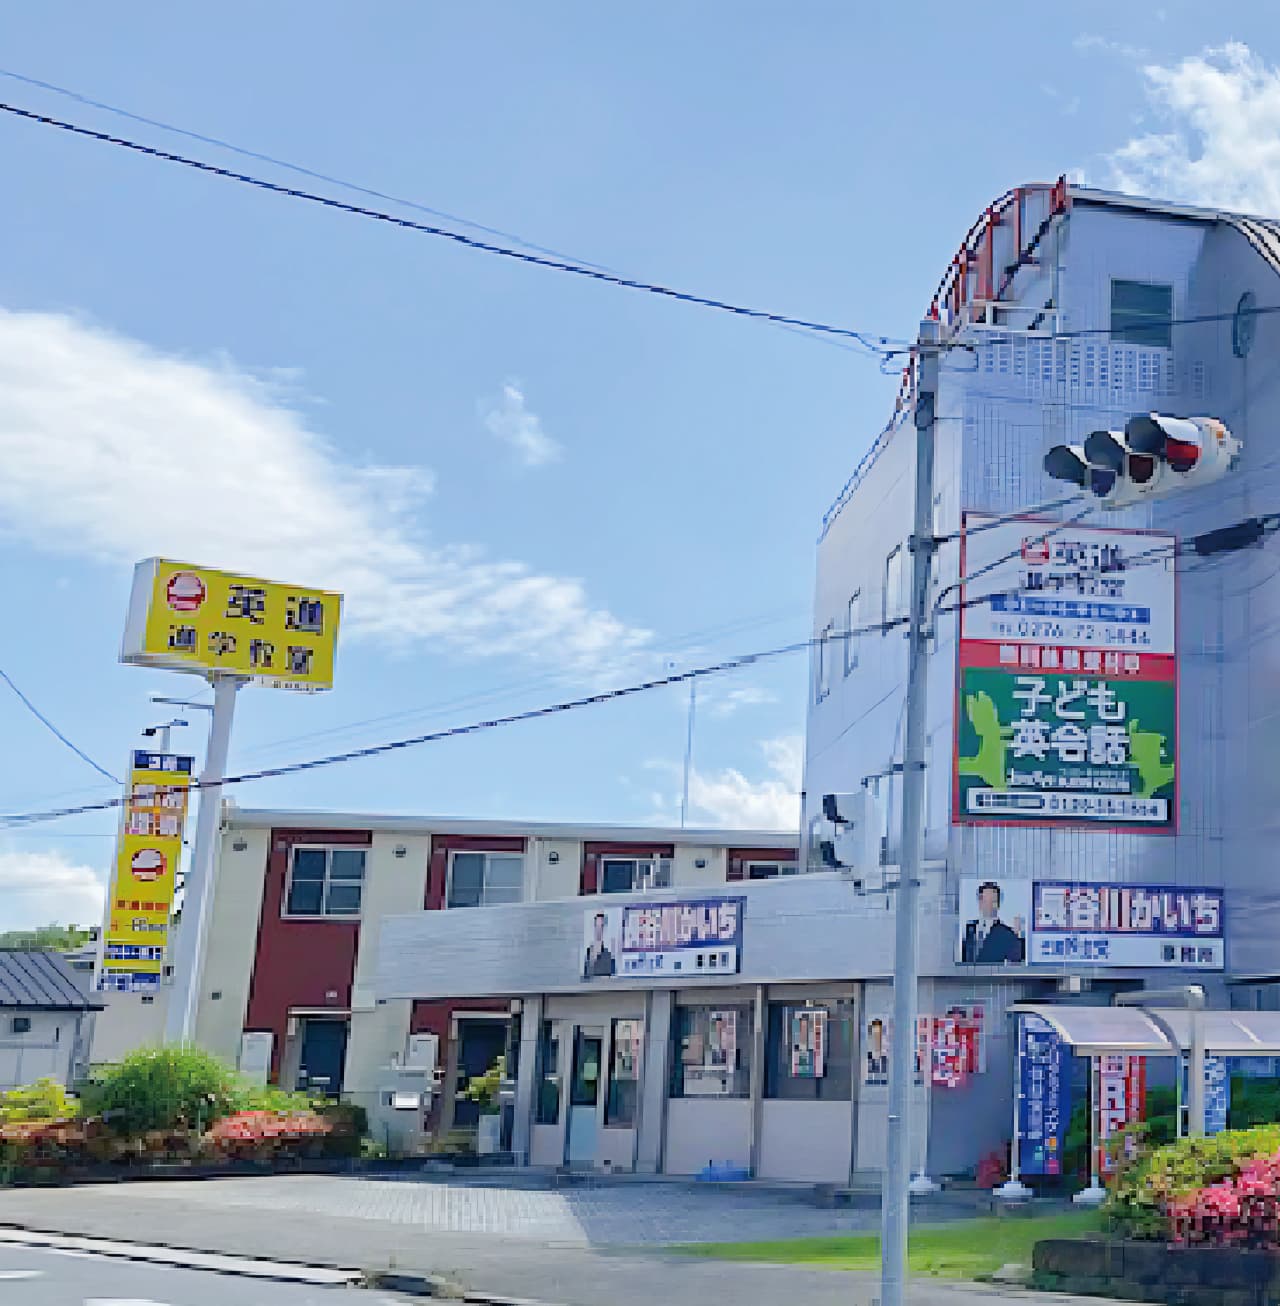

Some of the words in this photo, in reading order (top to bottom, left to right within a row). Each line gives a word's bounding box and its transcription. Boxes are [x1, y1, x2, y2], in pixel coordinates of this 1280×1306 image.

[223, 583, 325, 636] 英進
[167, 624, 314, 675] 進学教室
[1012, 676, 1126, 720] 子ども
[1007, 719, 1130, 765] 英会話
[1035, 887, 1222, 934] 長谷川かいち
